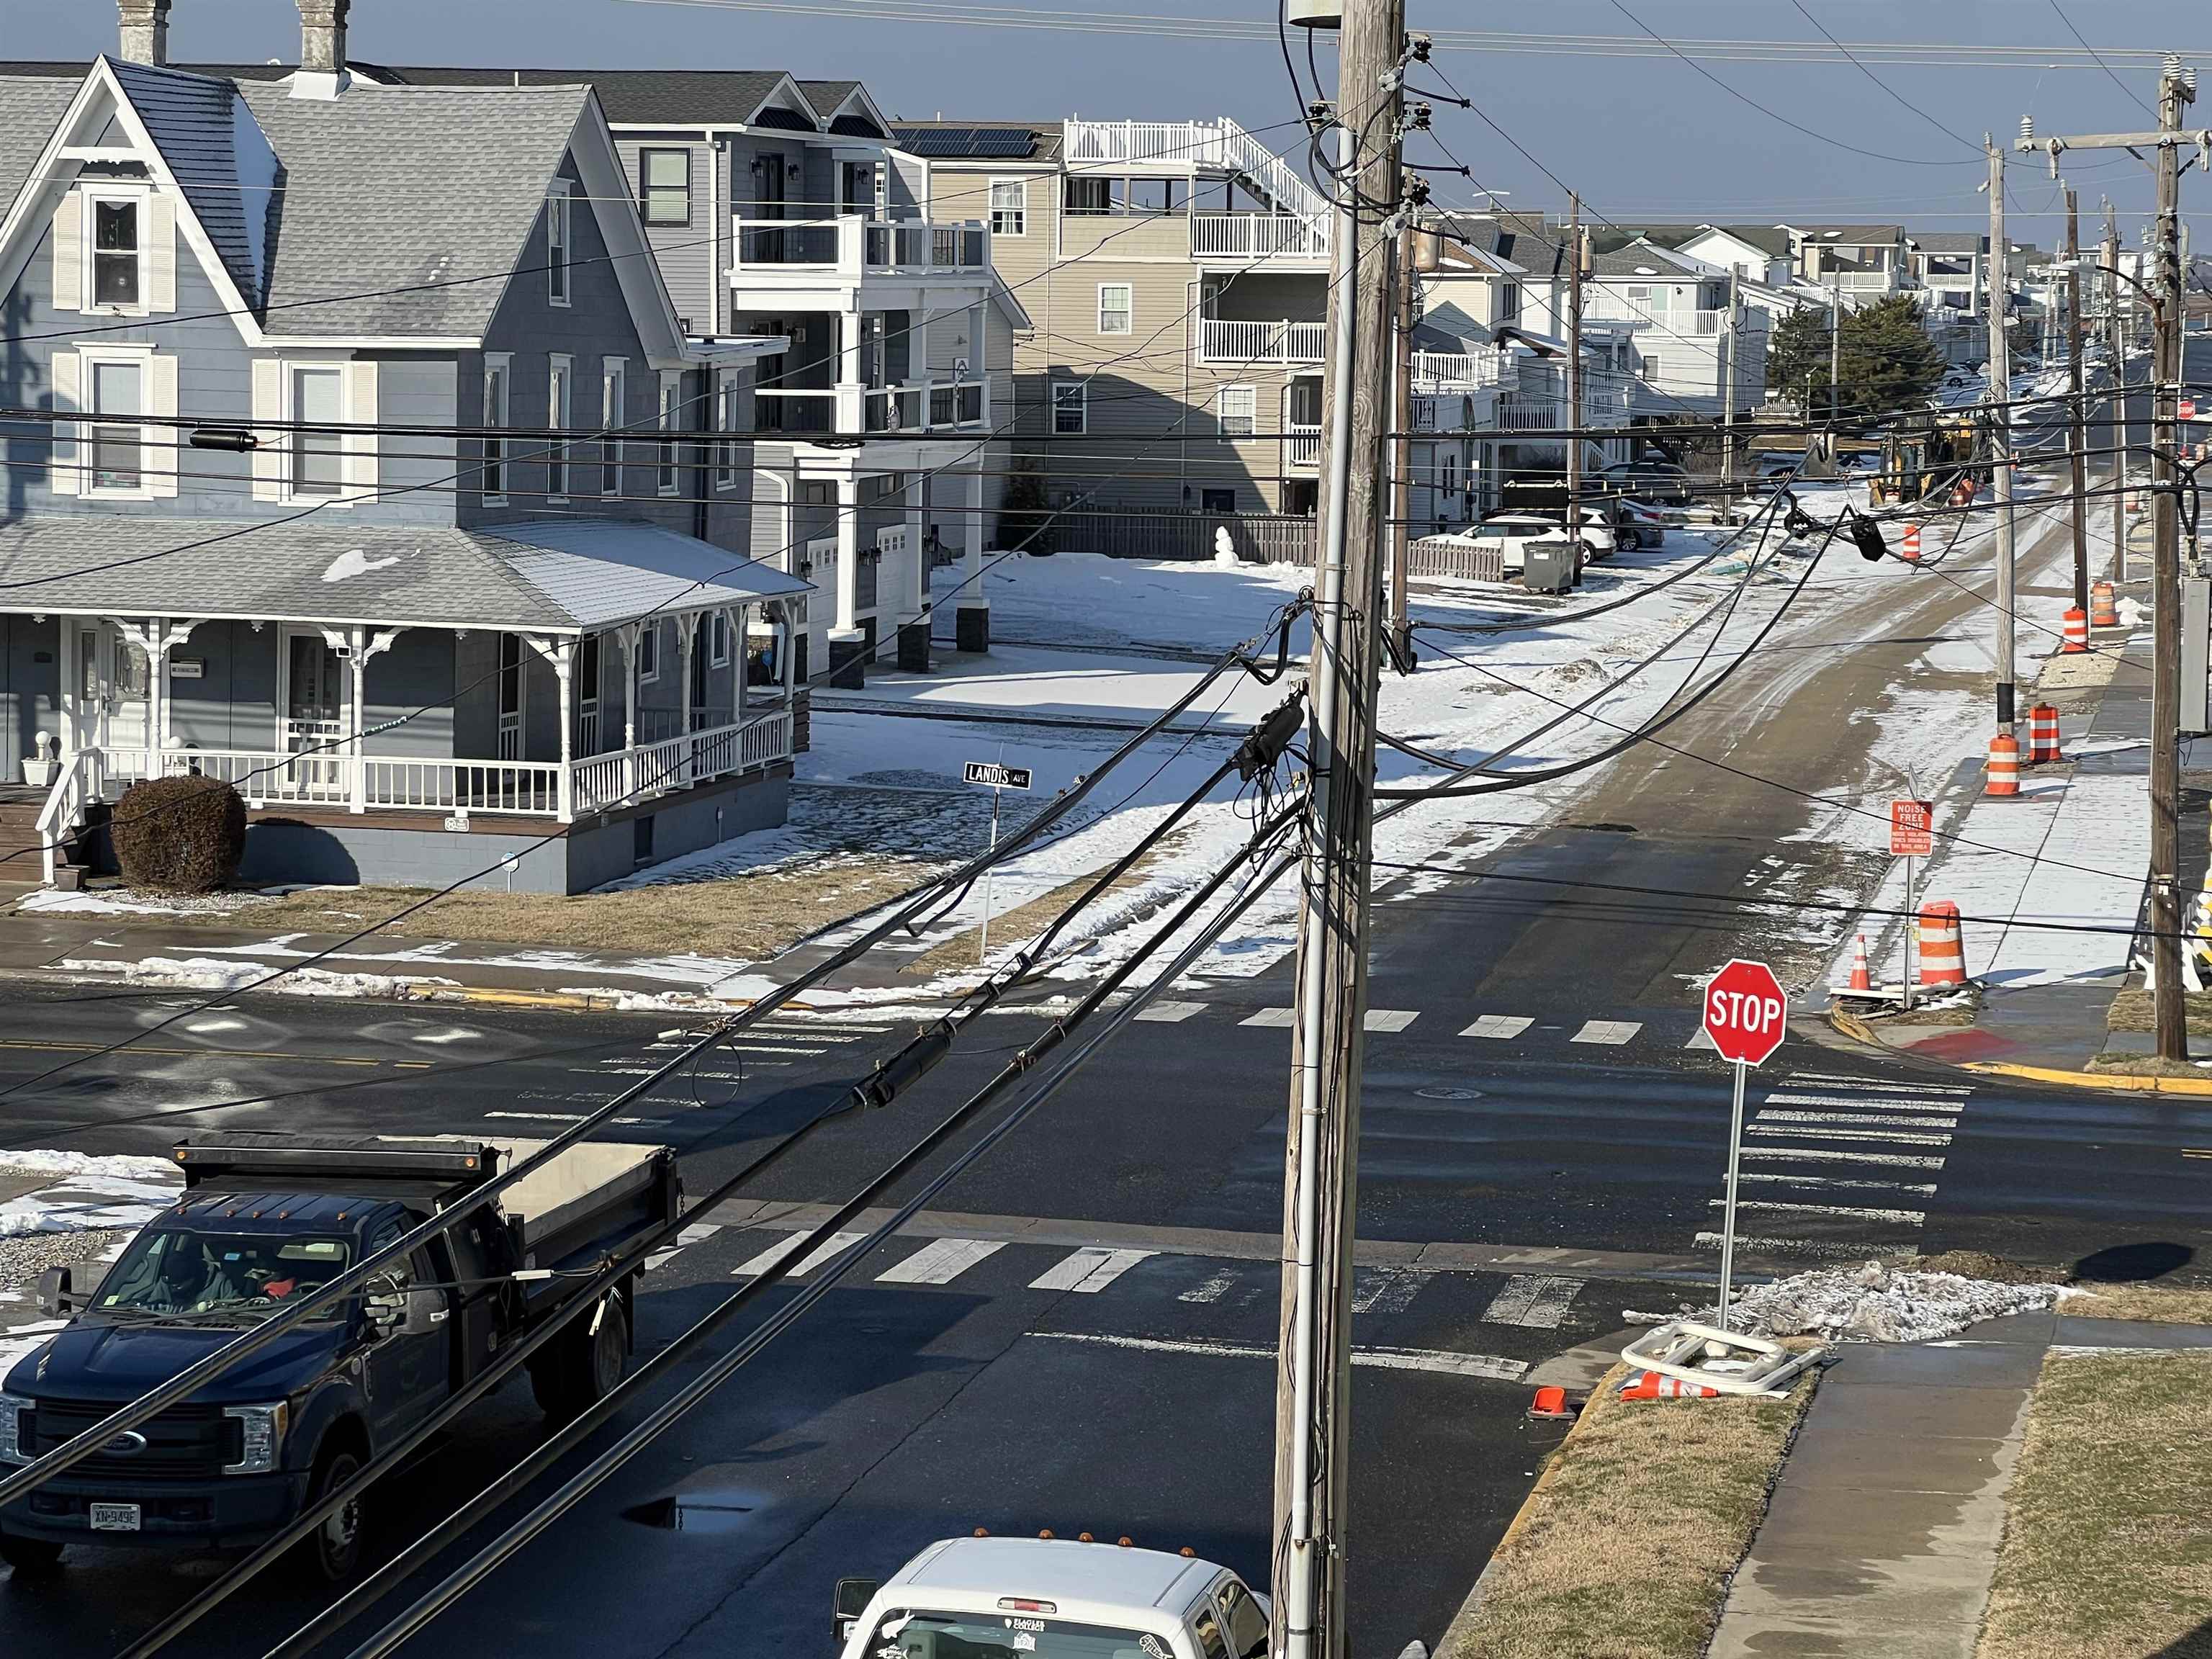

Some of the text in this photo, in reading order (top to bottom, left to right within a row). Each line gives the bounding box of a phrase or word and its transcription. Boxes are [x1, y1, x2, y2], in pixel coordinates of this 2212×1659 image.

[969, 765, 1026, 784] LANDIS AVE
[1899, 813, 1924, 822] FREE
[1709, 989, 1781, 1034] STOP
